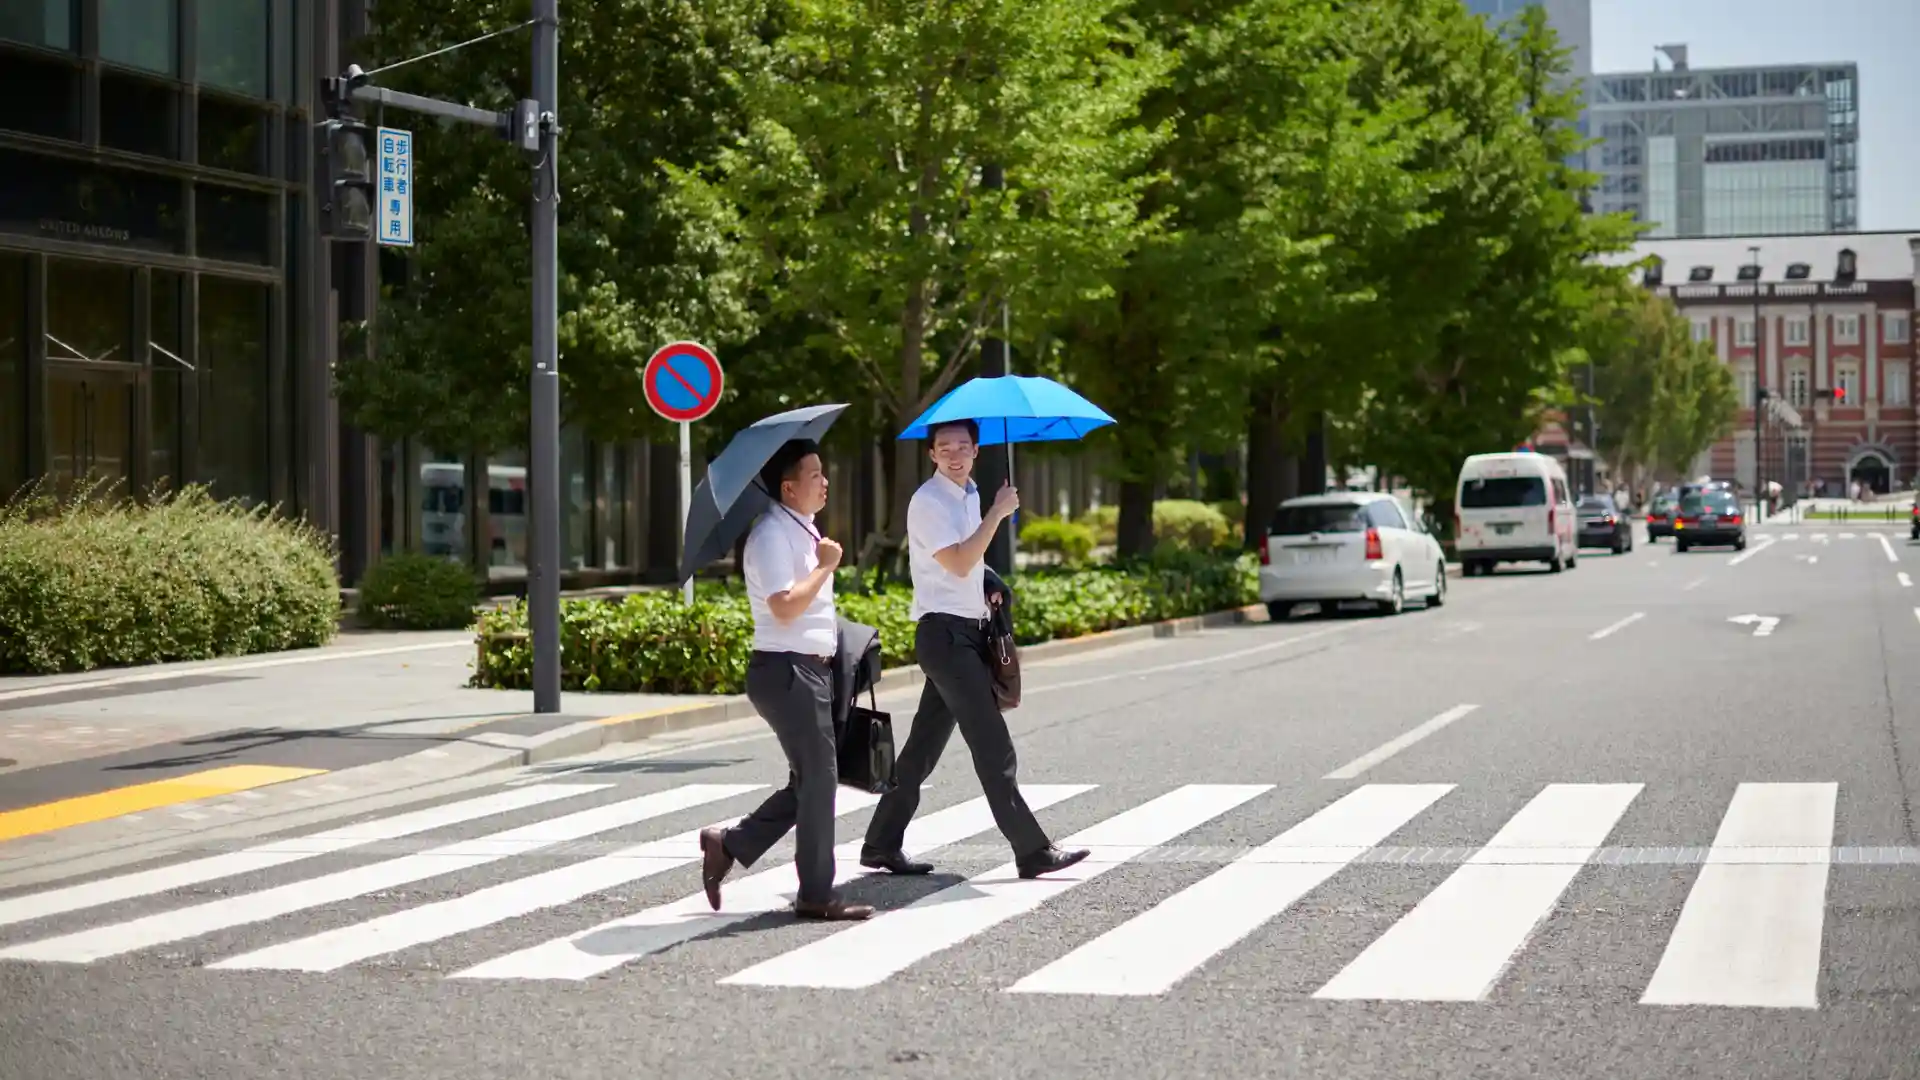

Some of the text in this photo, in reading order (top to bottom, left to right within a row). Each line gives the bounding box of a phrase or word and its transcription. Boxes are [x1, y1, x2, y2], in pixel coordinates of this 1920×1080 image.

[383, 137, 394, 192] 自転車
[396, 139, 408, 195] 歩行者
[40, 218, 81, 233] UNITED
[389, 199, 401, 237] 専用
